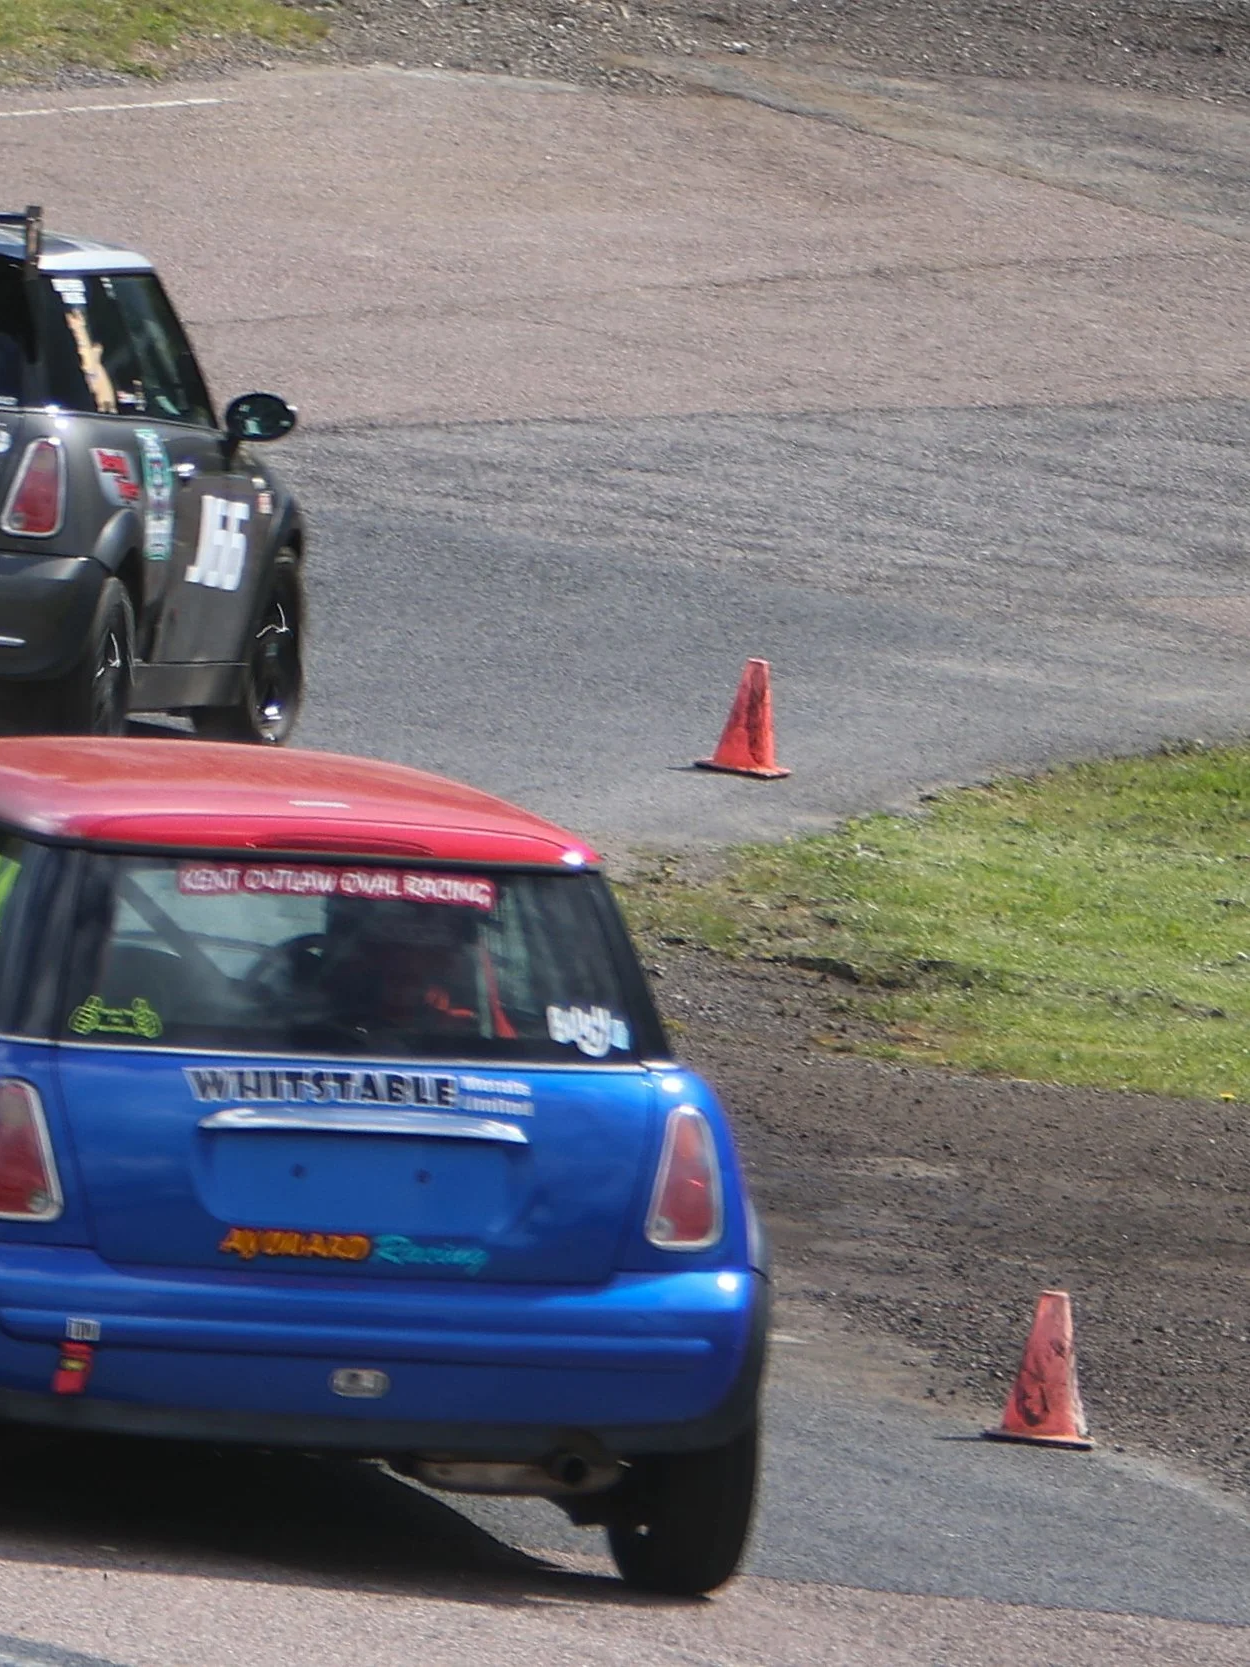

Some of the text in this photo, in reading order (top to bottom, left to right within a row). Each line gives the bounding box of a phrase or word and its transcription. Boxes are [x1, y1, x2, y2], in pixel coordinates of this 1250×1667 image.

[180, 867, 493, 907] KENT OUTLAW OVAL RACING
[182, 1067, 458, 1110] WHITSTABLE
